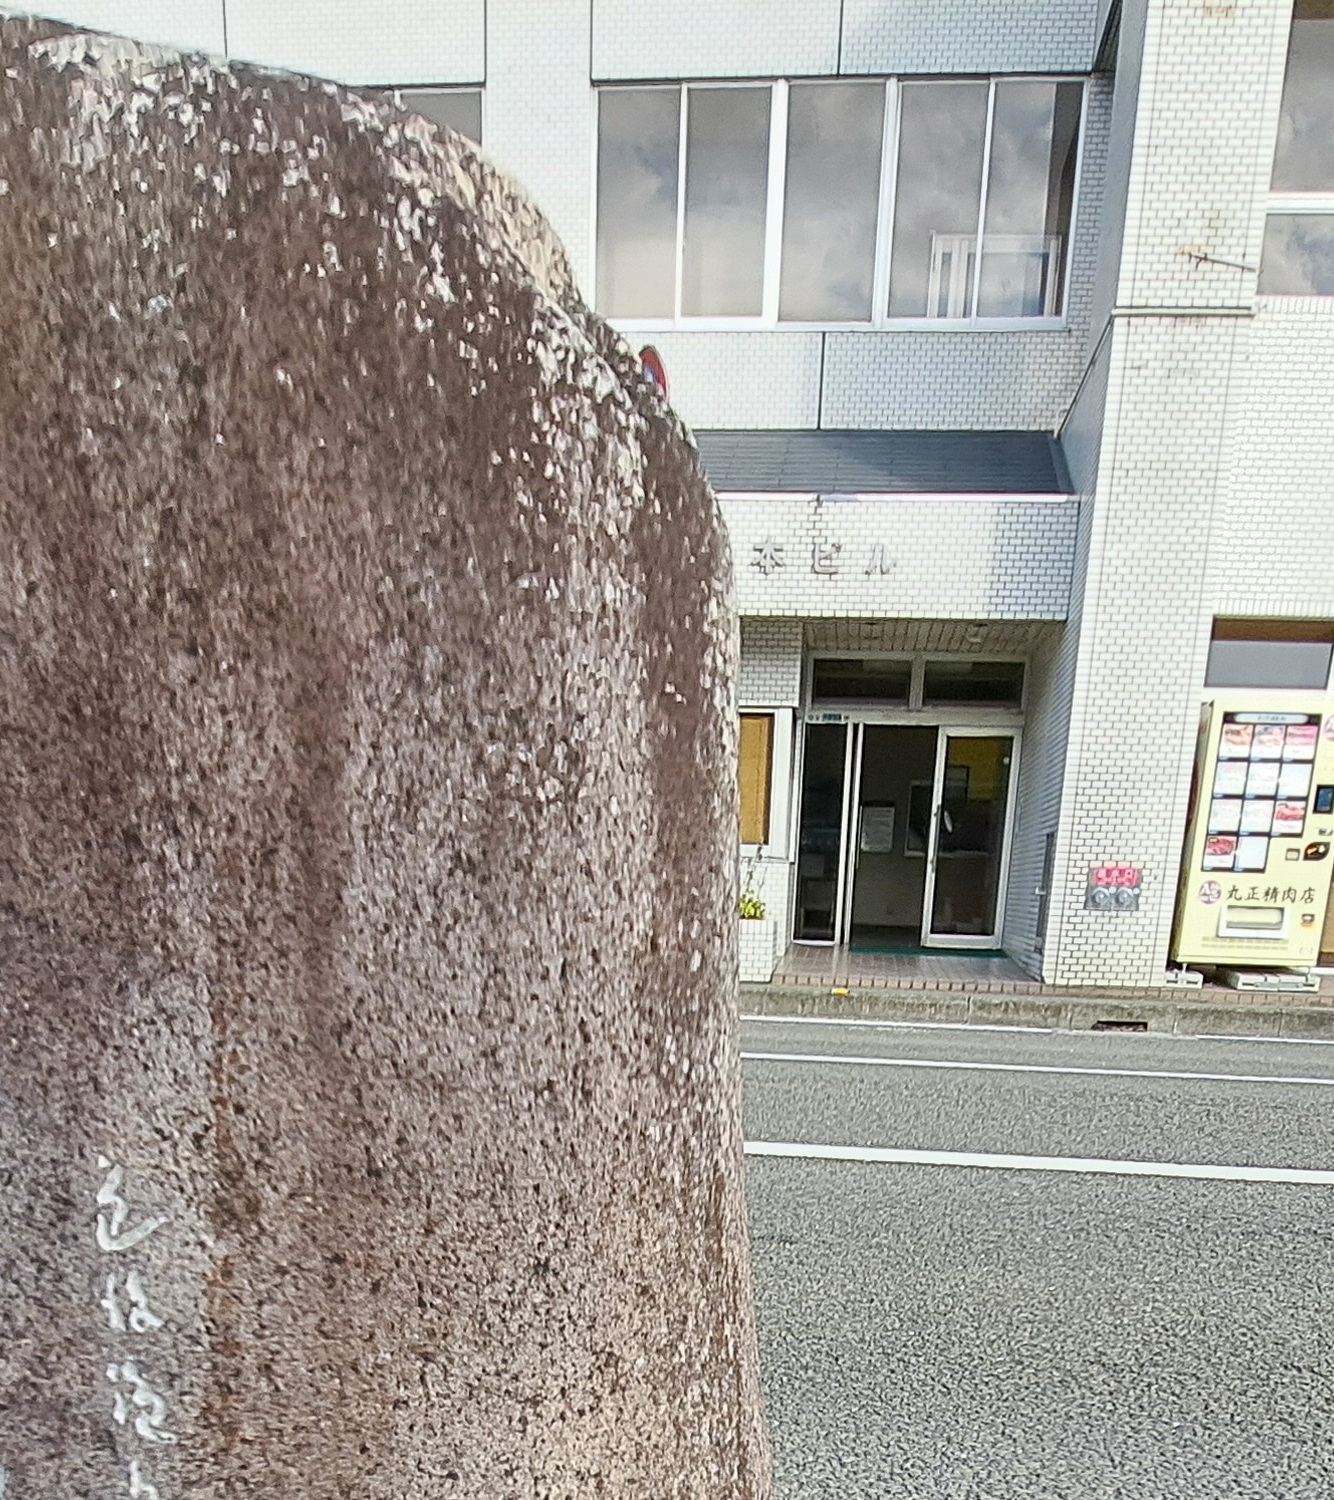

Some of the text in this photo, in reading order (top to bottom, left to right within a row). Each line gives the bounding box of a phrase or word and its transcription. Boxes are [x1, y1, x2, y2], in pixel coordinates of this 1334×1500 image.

[1226, 884, 1316, 904] 丸正精肉店
